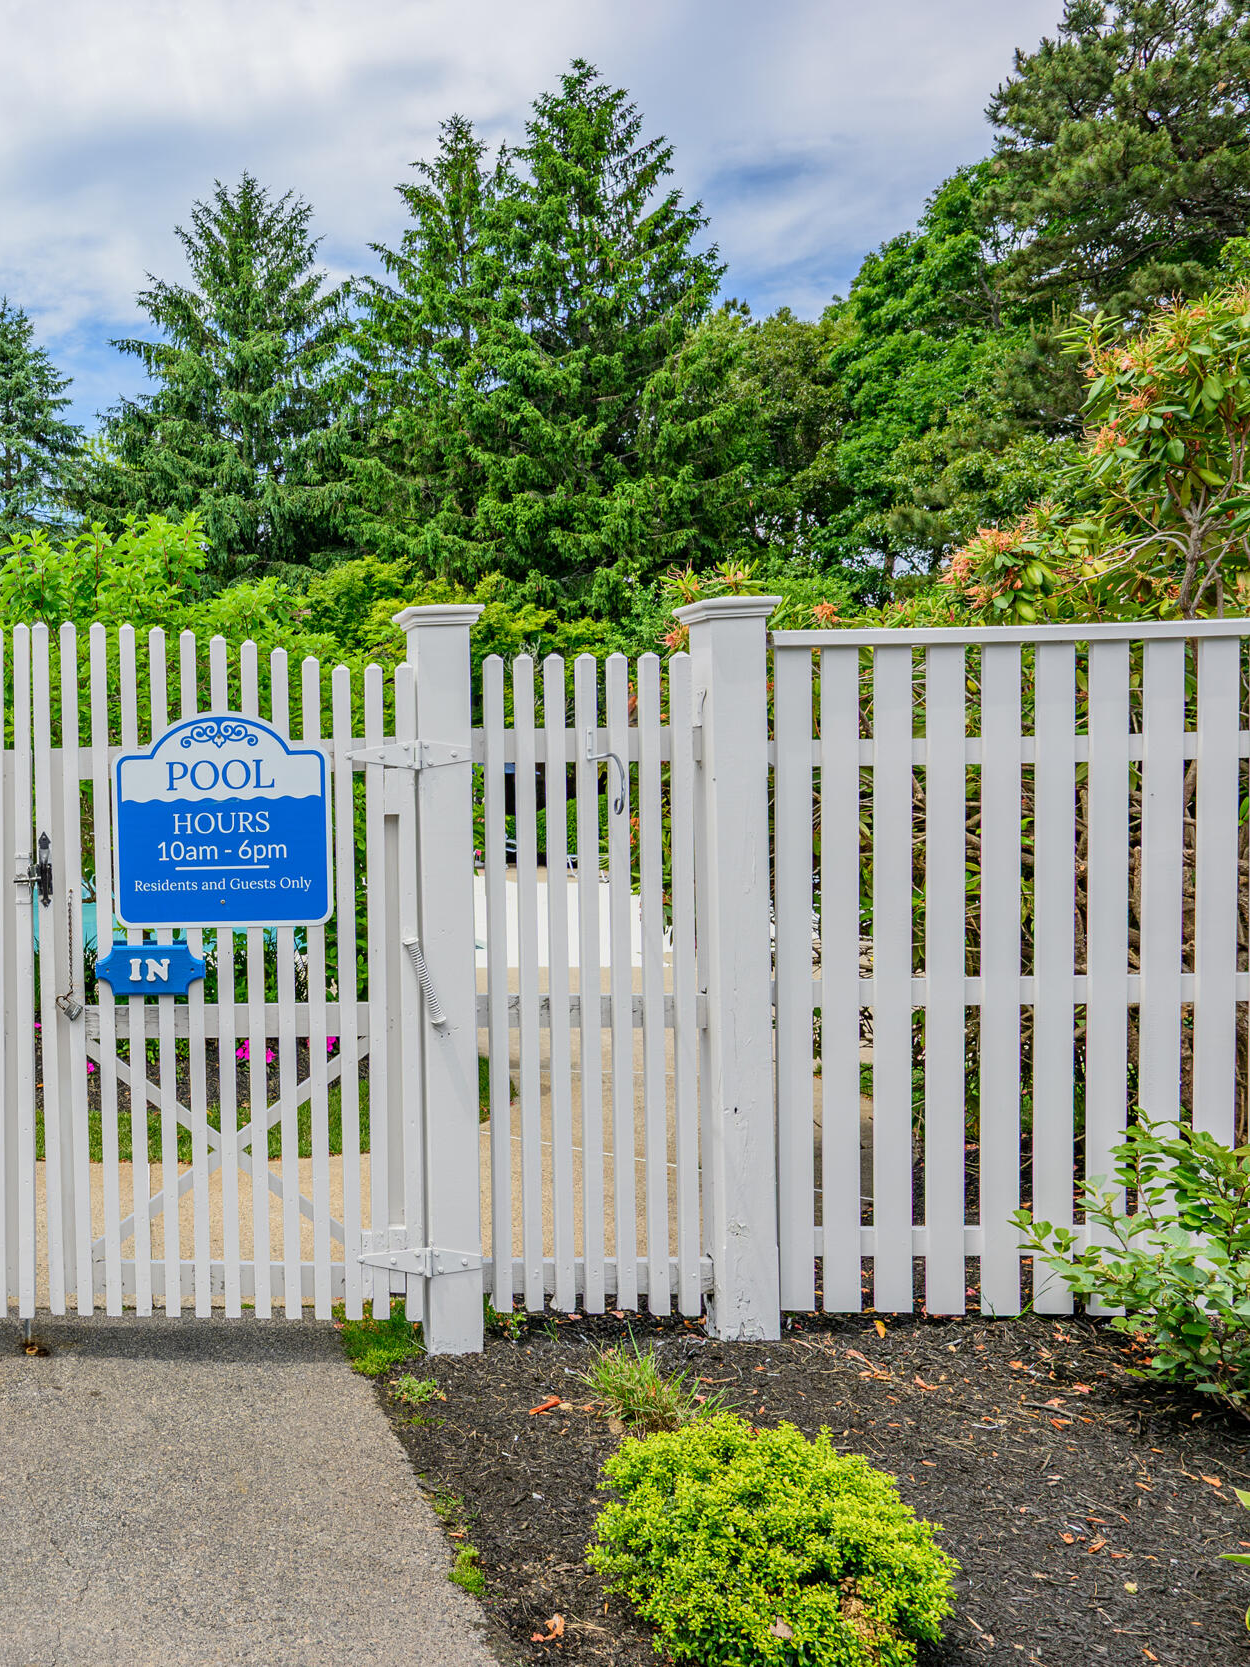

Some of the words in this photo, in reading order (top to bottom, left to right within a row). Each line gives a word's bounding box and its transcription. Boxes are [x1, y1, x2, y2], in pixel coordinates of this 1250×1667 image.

[166, 759, 275, 792] POOL
[173, 811, 270, 835] HOURS
[158, 841, 218, 861] 10am
[238, 840, 287, 863] 6pm
[134, 879, 198, 892] Residents
[201, 878, 226, 890] and
[230, 878, 276, 890] Guests
[280, 877, 312, 891] Only
[129, 958, 170, 983] IN
